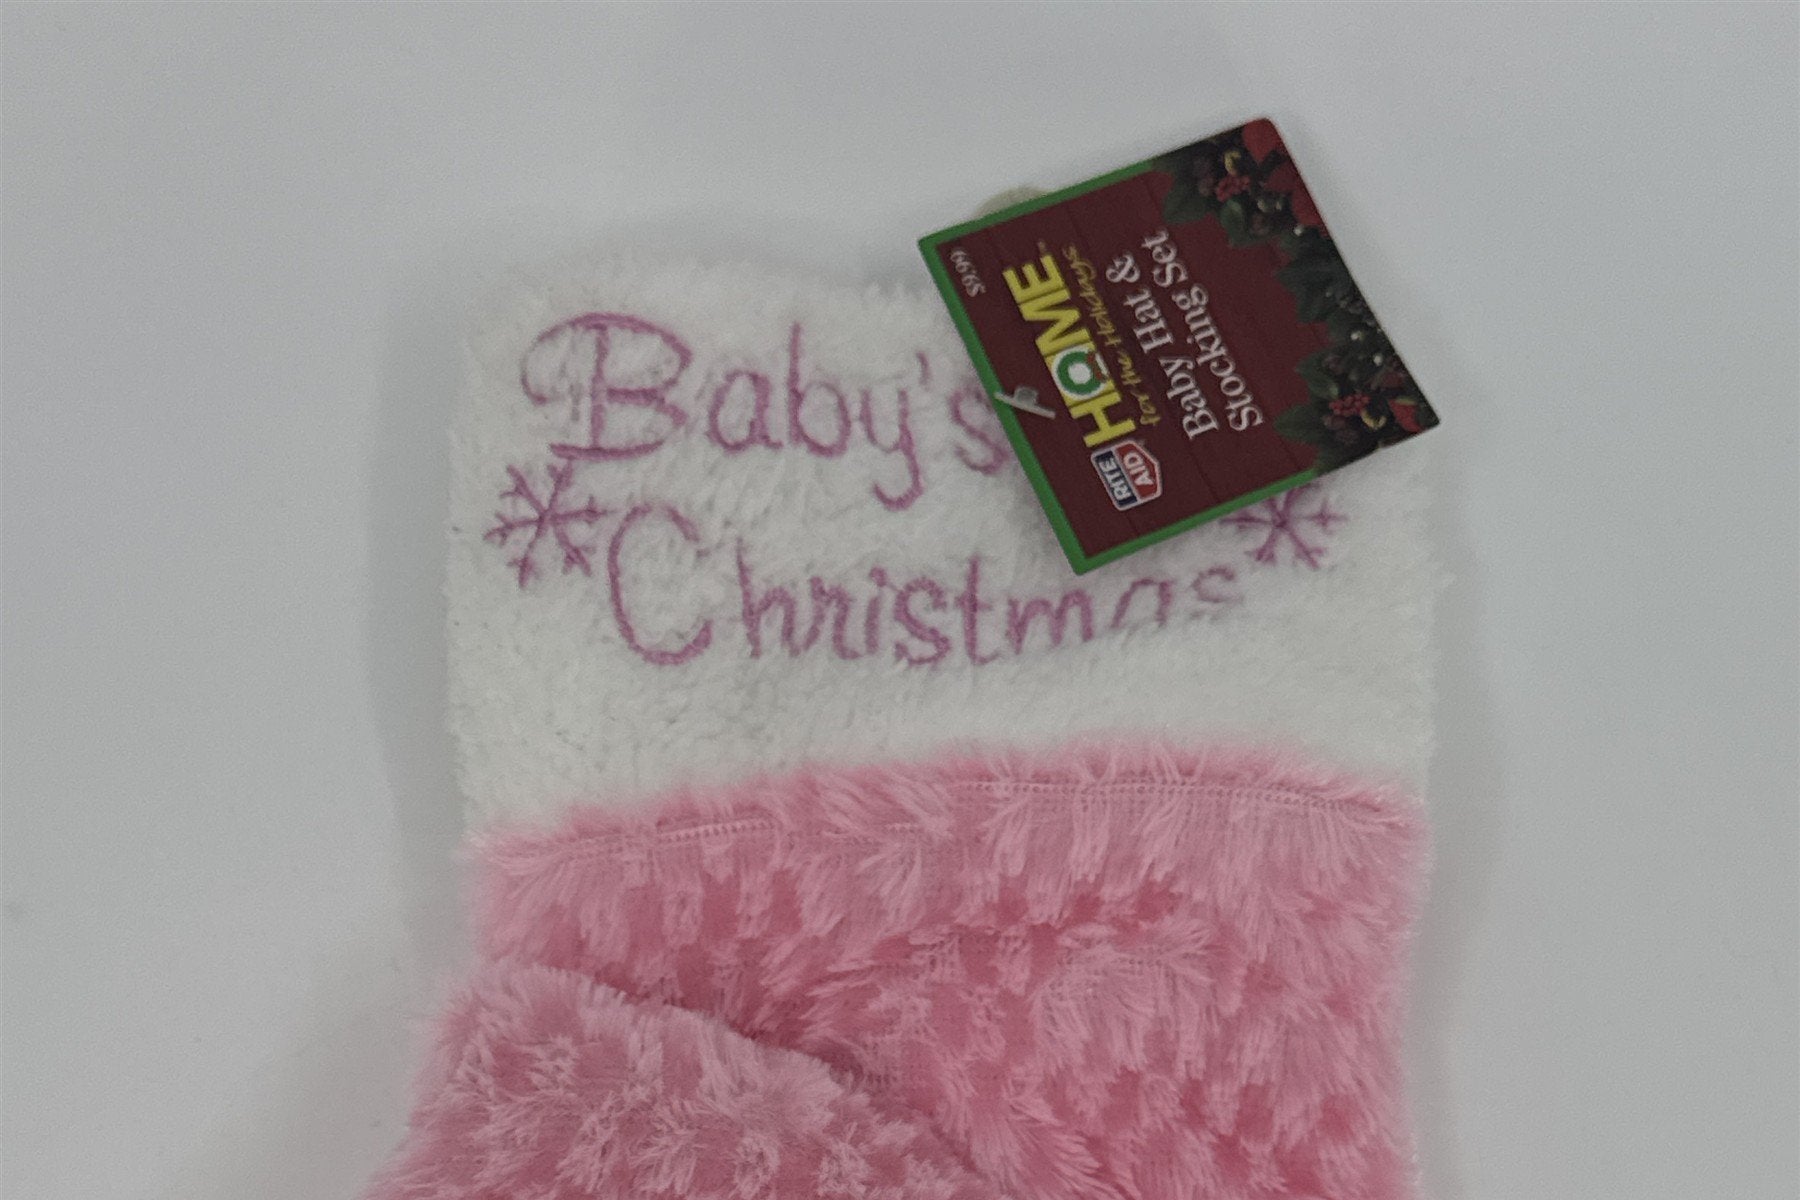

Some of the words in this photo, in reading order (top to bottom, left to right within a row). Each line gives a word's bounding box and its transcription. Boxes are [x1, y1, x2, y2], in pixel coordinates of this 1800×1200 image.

[950, 249, 987, 298] $9.99
[1105, 252, 1141, 283] &
[1141, 229, 1189, 287] Set
[1062, 247, 1122, 346] Holidays
[1123, 288, 1174, 354] Hat
[1117, 350, 1143, 386] the
[1172, 283, 1264, 432] Stocking
[521, 312, 1010, 510] Baby's
[1130, 386, 1161, 426] for
[1159, 356, 1220, 440] Baby
[1098, 457, 1132, 501] RITE
[1122, 451, 1154, 486] AID
